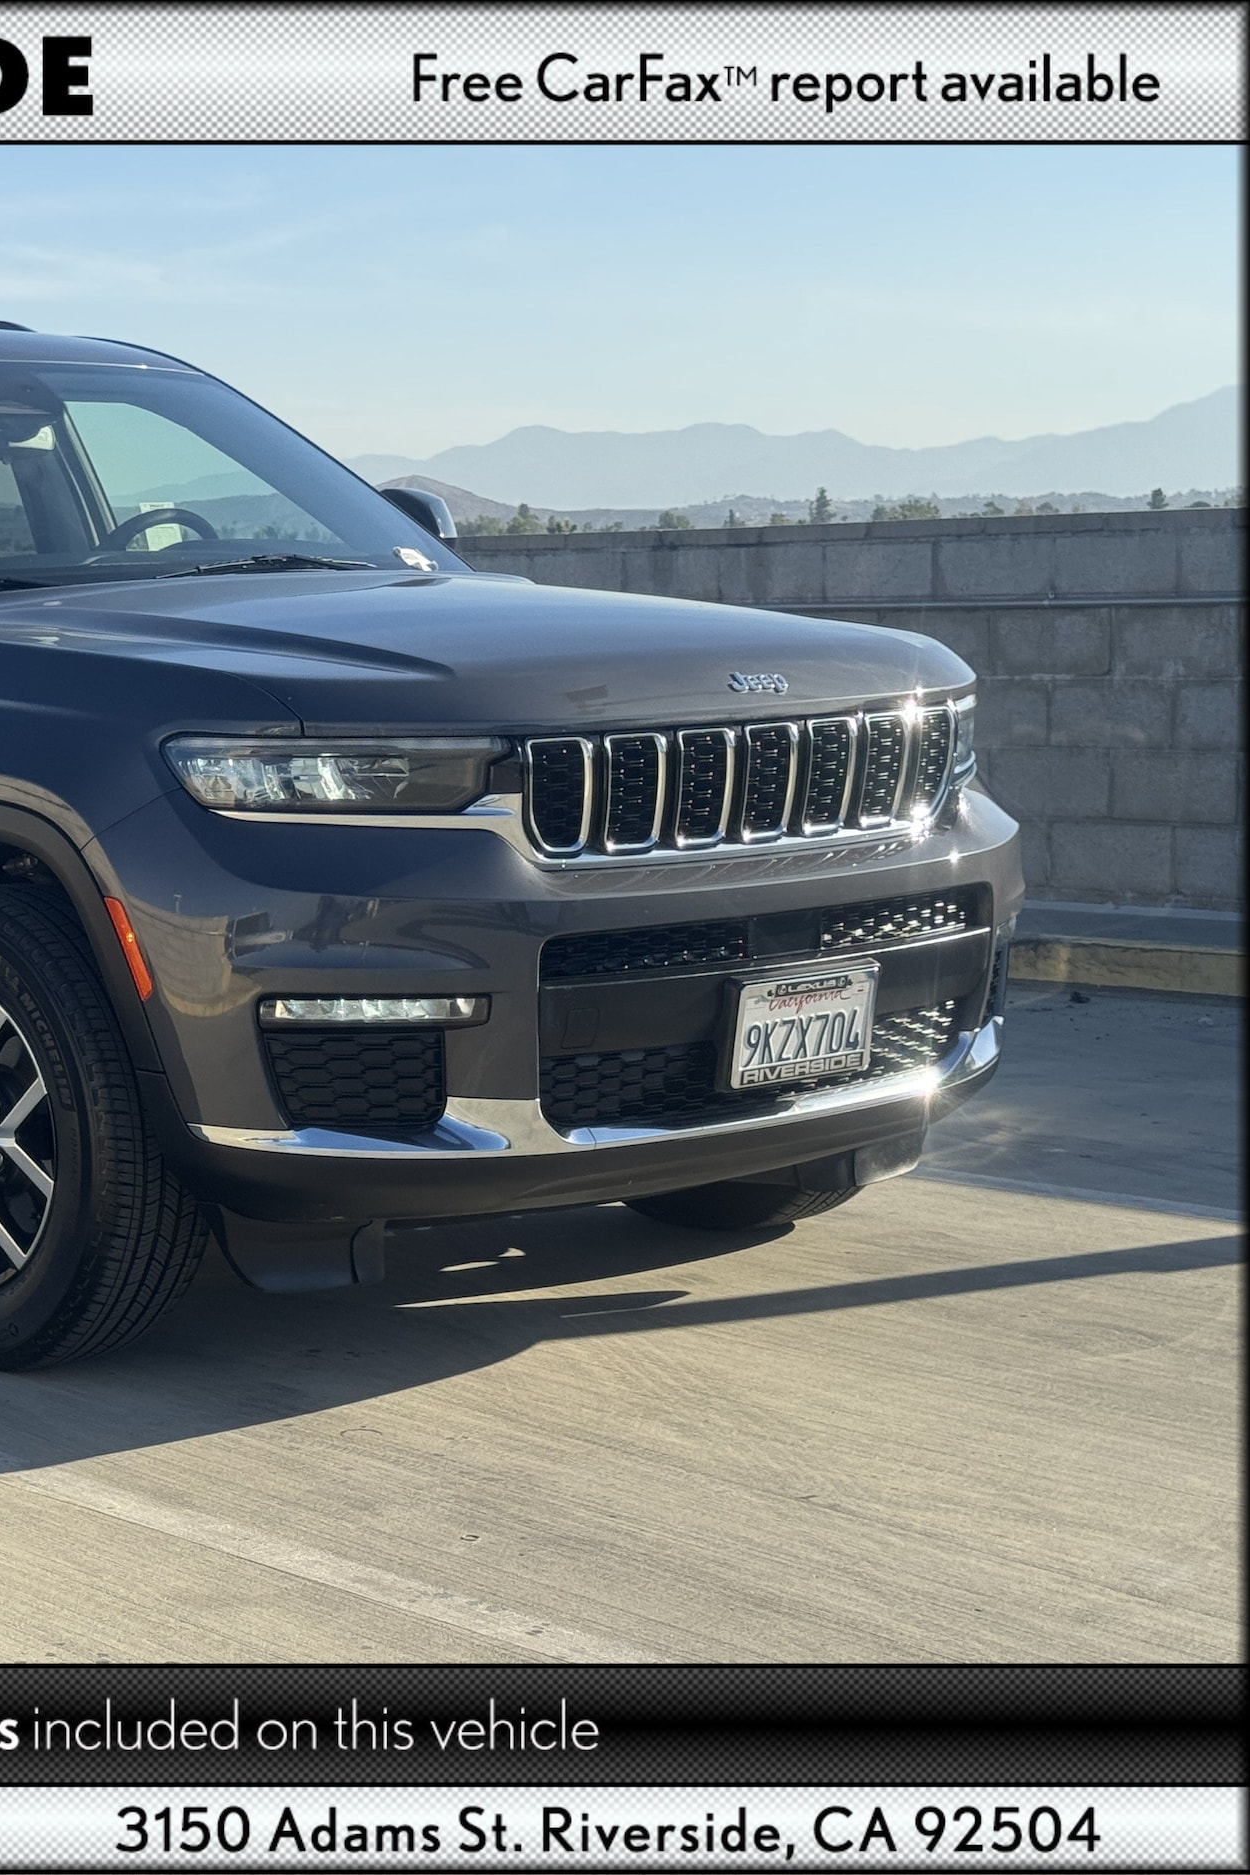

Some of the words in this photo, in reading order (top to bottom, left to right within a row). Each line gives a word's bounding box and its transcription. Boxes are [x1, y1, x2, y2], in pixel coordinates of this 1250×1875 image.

[727, 671, 789, 694] Jeep
[788, 979, 837, 993] LEXUS
[18, 992, 73, 1106] MICHELIN
[742, 1008, 861, 1068] 9KZX704
[742, 1053, 862, 1085] RIVERSIDE
